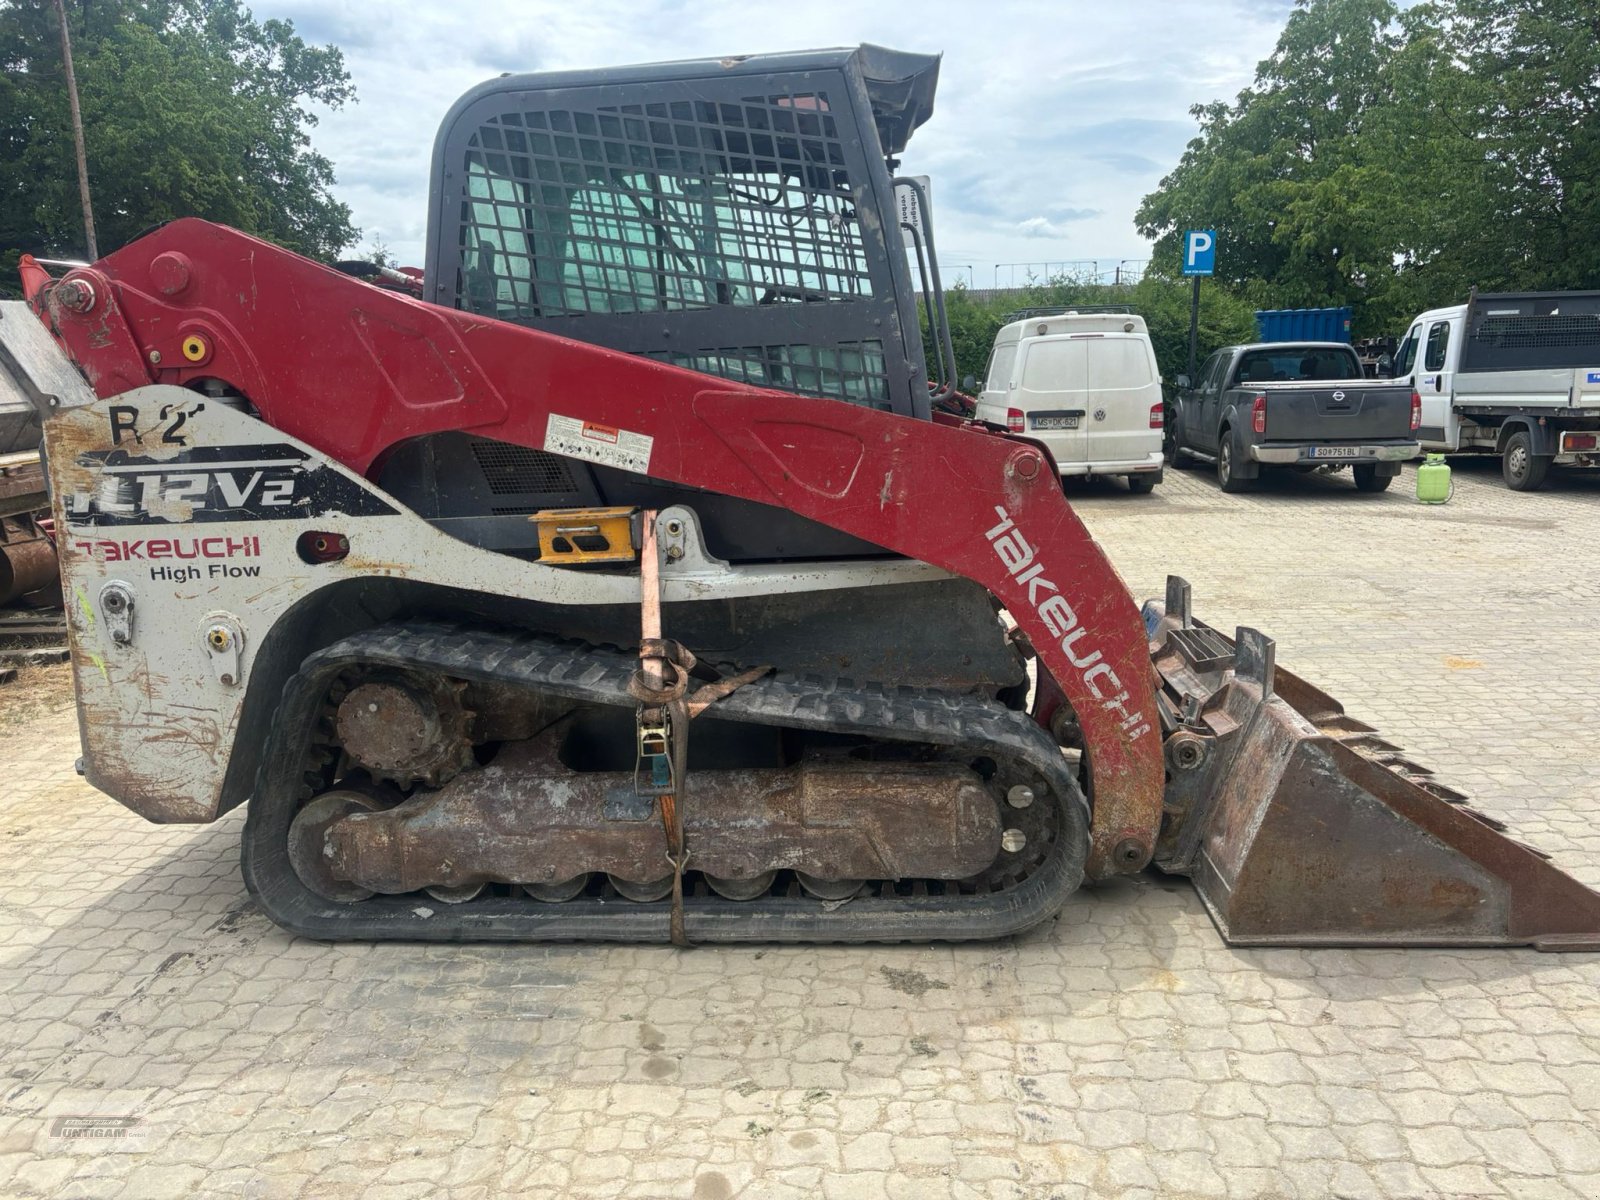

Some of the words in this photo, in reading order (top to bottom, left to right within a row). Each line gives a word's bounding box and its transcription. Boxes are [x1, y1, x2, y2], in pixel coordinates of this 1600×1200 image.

[1188, 233, 1212, 266] P
[150, 566, 201, 584] High
[208, 564, 261, 579] Flow
